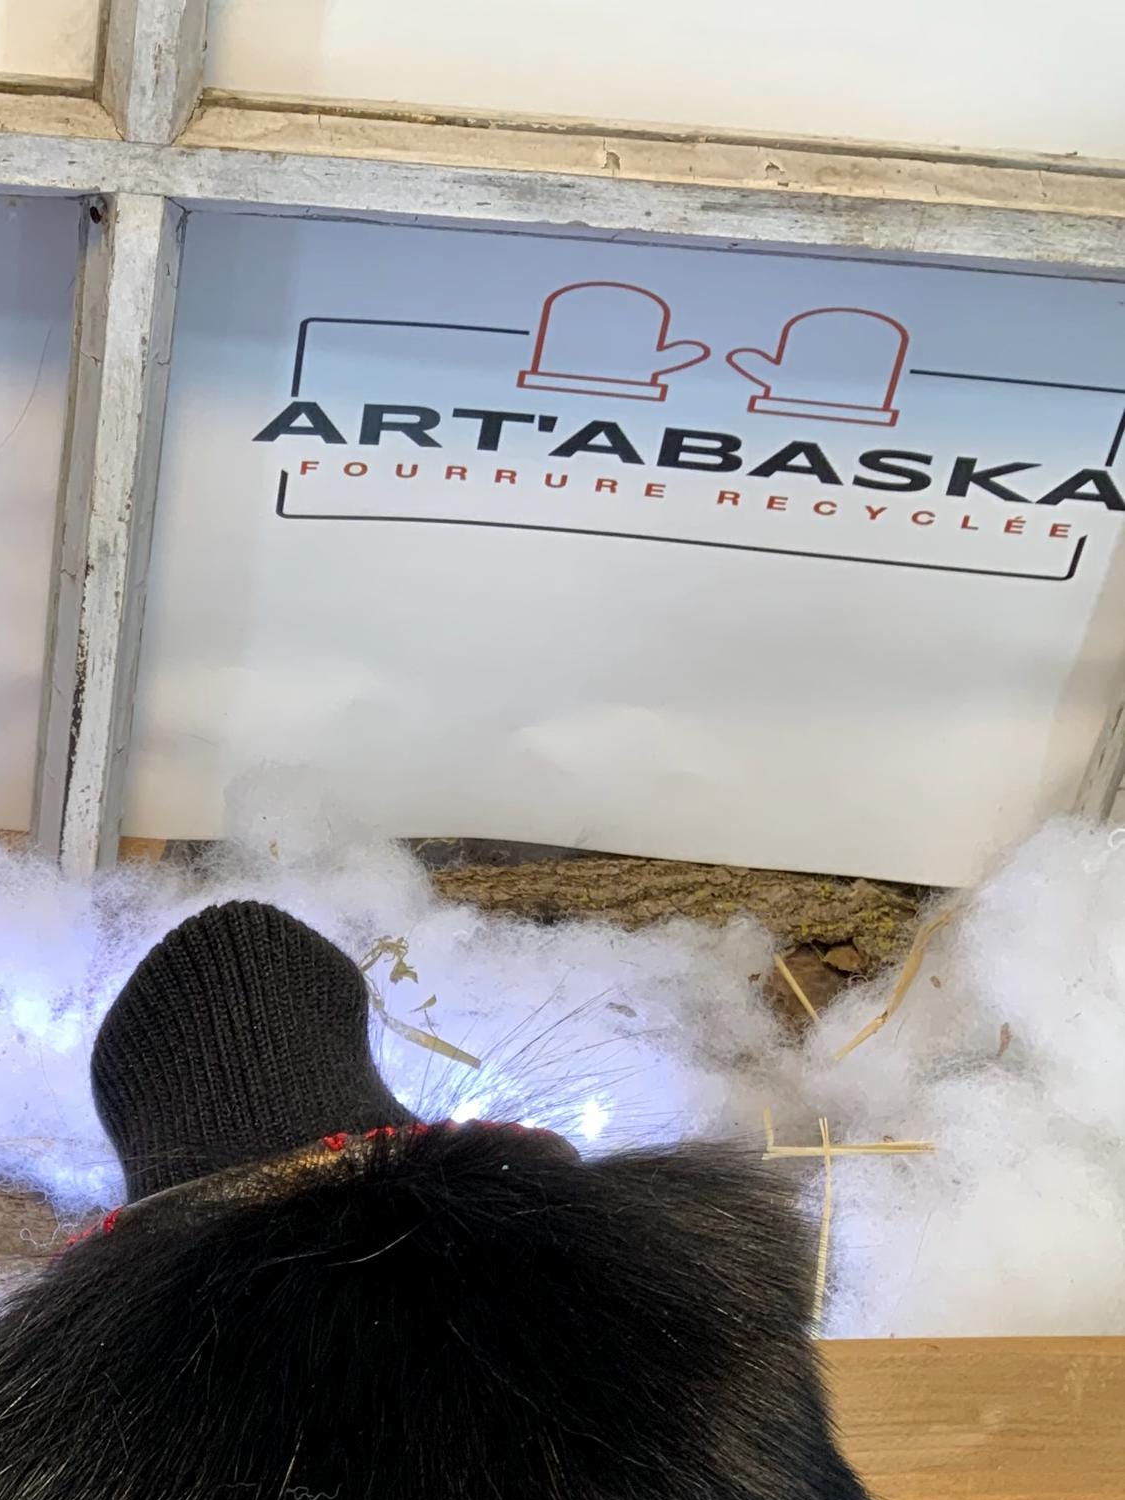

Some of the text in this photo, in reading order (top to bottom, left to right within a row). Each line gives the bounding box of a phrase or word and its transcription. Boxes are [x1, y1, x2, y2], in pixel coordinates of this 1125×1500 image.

[252, 400, 1125, 512] ART'ABASKA
[299, 460, 1072, 539] FOURRURE RECYCLÉE
